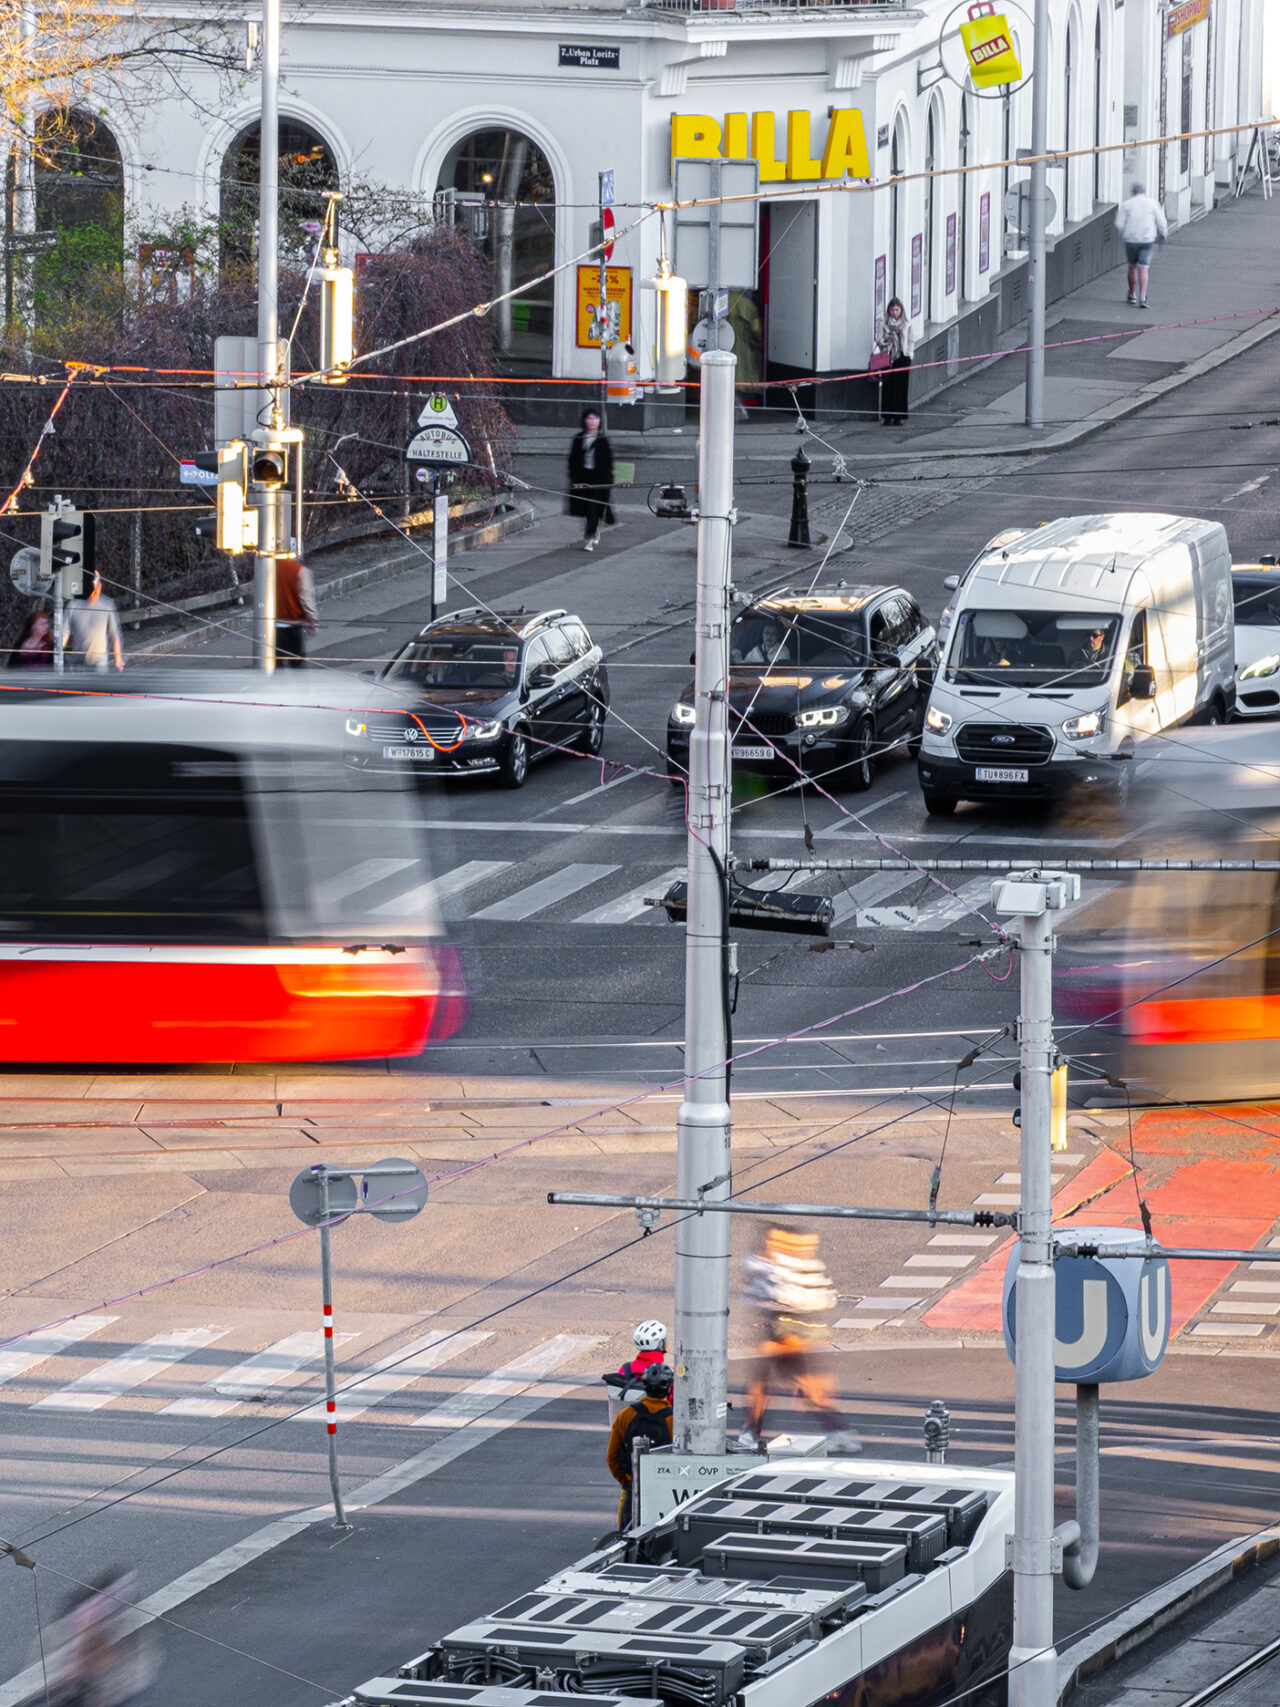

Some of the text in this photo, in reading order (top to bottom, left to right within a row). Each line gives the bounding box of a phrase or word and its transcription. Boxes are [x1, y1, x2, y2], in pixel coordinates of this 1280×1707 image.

[972, 38, 1008, 62] BILLA
[579, 57, 599, 65] Platz
[671, 108, 870, 182] BILLA
[420, 430, 457, 444] AUTOBUS
[412, 450, 462, 459] HALTESTELLE
[1141, 1266, 1165, 1362] U
[699, 1465, 719, 1476] ÖVP
